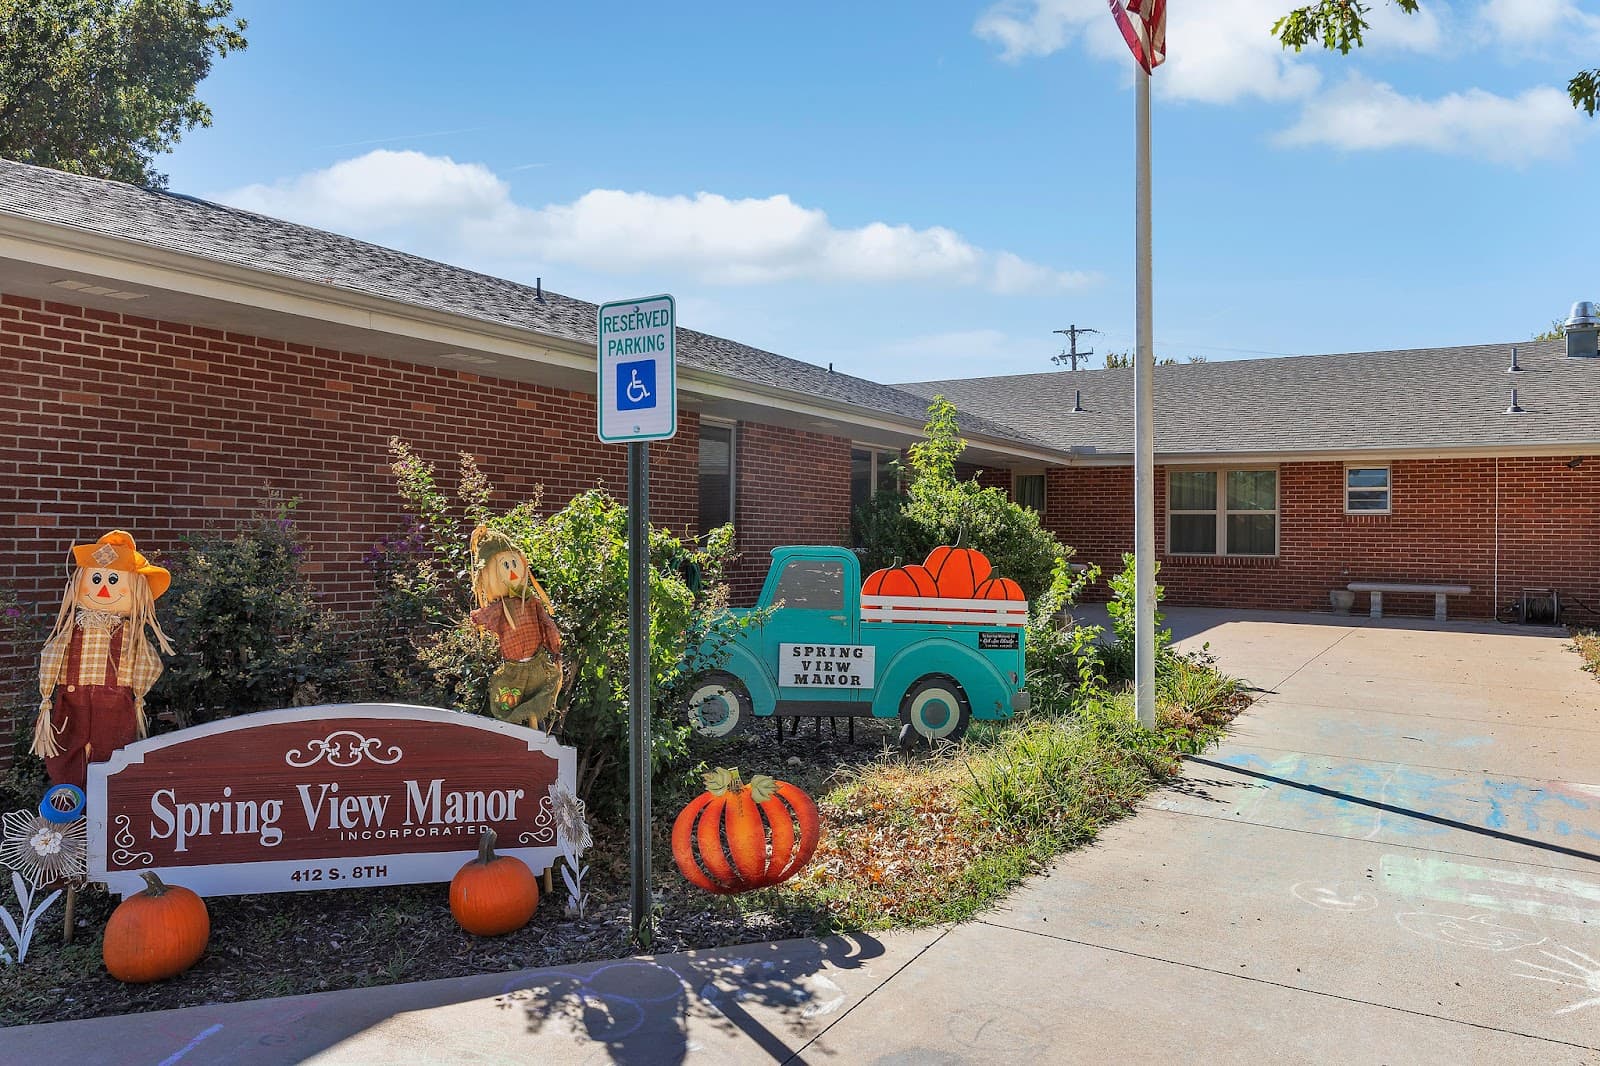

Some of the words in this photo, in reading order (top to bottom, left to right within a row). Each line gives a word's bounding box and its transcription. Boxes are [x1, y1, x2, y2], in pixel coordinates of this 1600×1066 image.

[603, 309, 669, 334] RESERVED
[608, 334, 665, 357] PARKING
[792, 646, 864, 659] SPRING
[801, 660, 851, 673] VIEW
[793, 673, 862, 686] MANOR
[150, 786, 284, 852] Spring
[295, 782, 392, 832] View
[402, 778, 525, 827] Manor
[339, 824, 490, 841] INCORPORATED
[290, 869, 323, 882] 412
[328, 867, 346, 881] S.
[352, 865, 388, 879] 8TH
